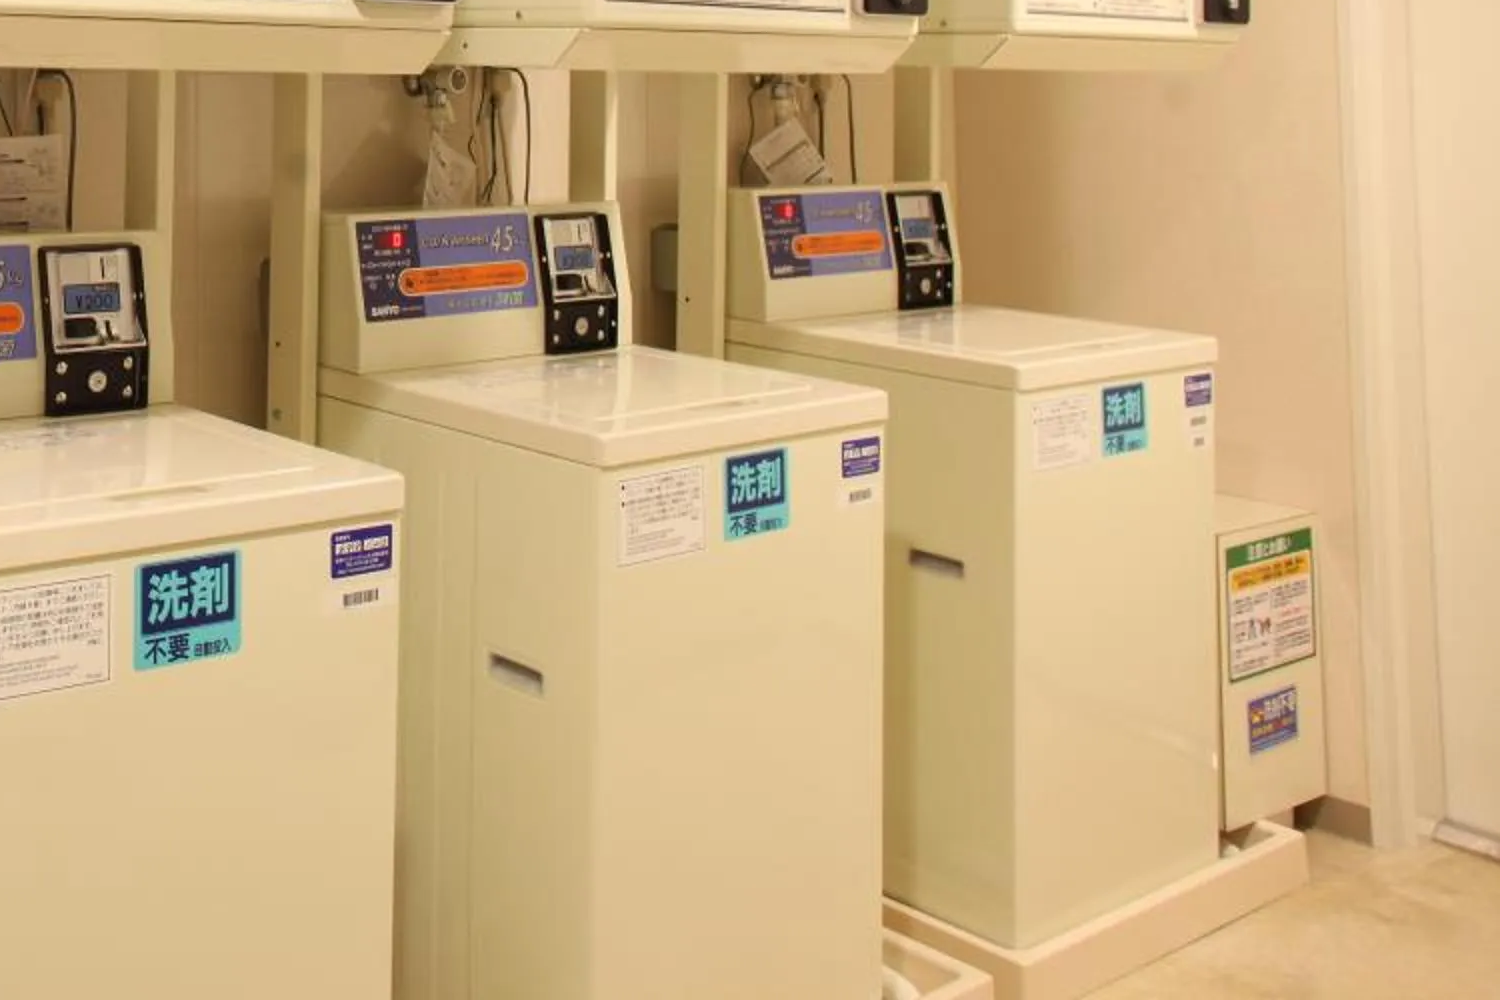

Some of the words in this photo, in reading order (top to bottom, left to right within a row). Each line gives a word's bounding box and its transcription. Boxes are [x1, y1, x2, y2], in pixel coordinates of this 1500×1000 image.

[731, 457, 781, 505] 洗剤
[730, 513, 757, 536] 不要
[147, 562, 229, 624] 洗剤
[144, 633, 191, 665] 不要
